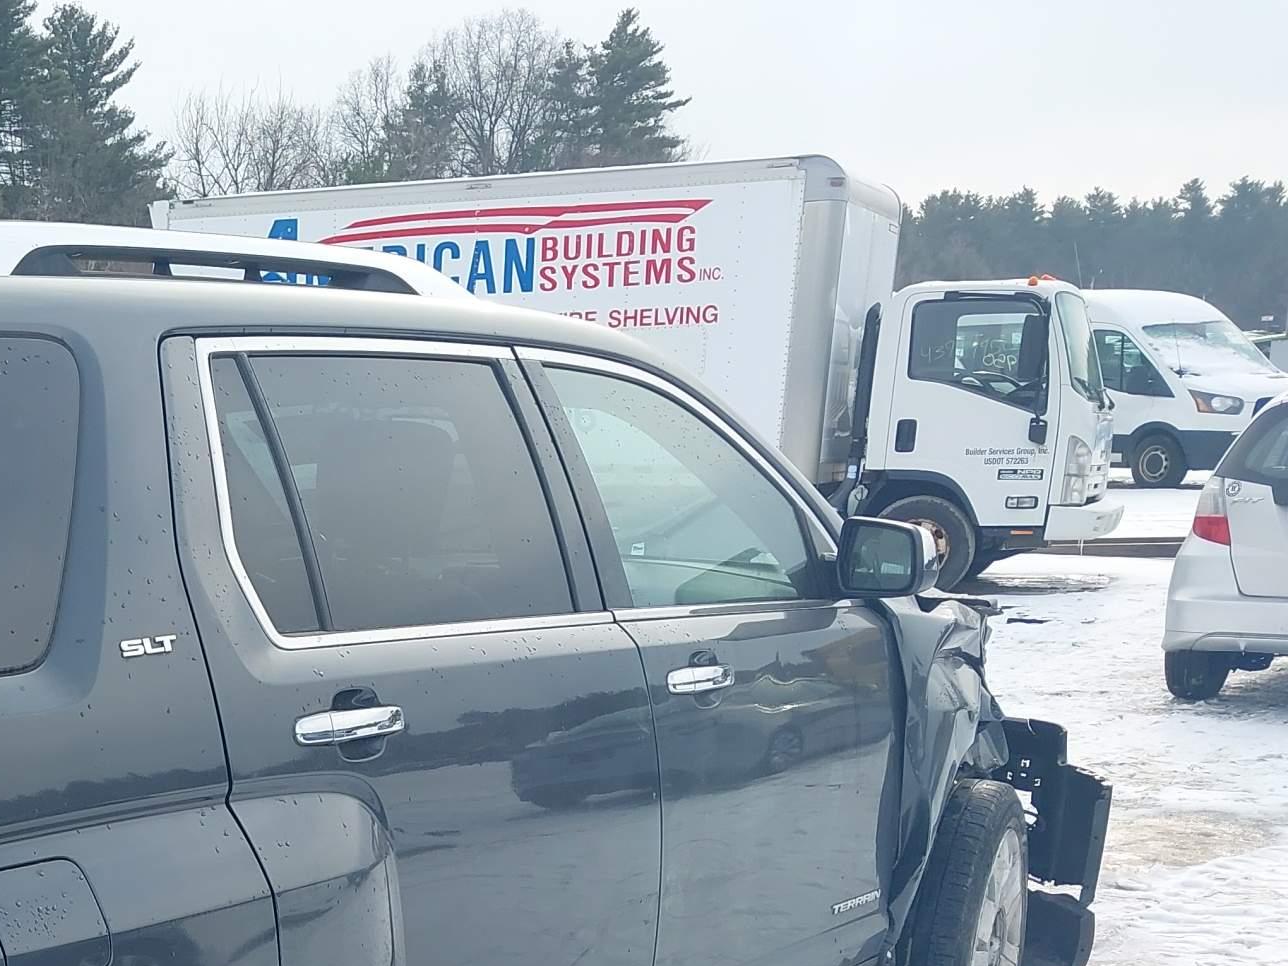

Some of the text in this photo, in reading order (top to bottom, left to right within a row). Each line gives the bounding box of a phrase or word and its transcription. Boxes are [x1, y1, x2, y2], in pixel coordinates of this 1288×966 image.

[541, 225, 696, 262] BUILDING
[539, 256, 725, 292] SYSTEMS INC.
[608, 305, 719, 328] SHELVING
[965, 447, 987, 456] Builder
[988, 447, 1015, 456] Services
[119, 634, 177, 658] SLT
[832, 889, 881, 915] TERRAIN
